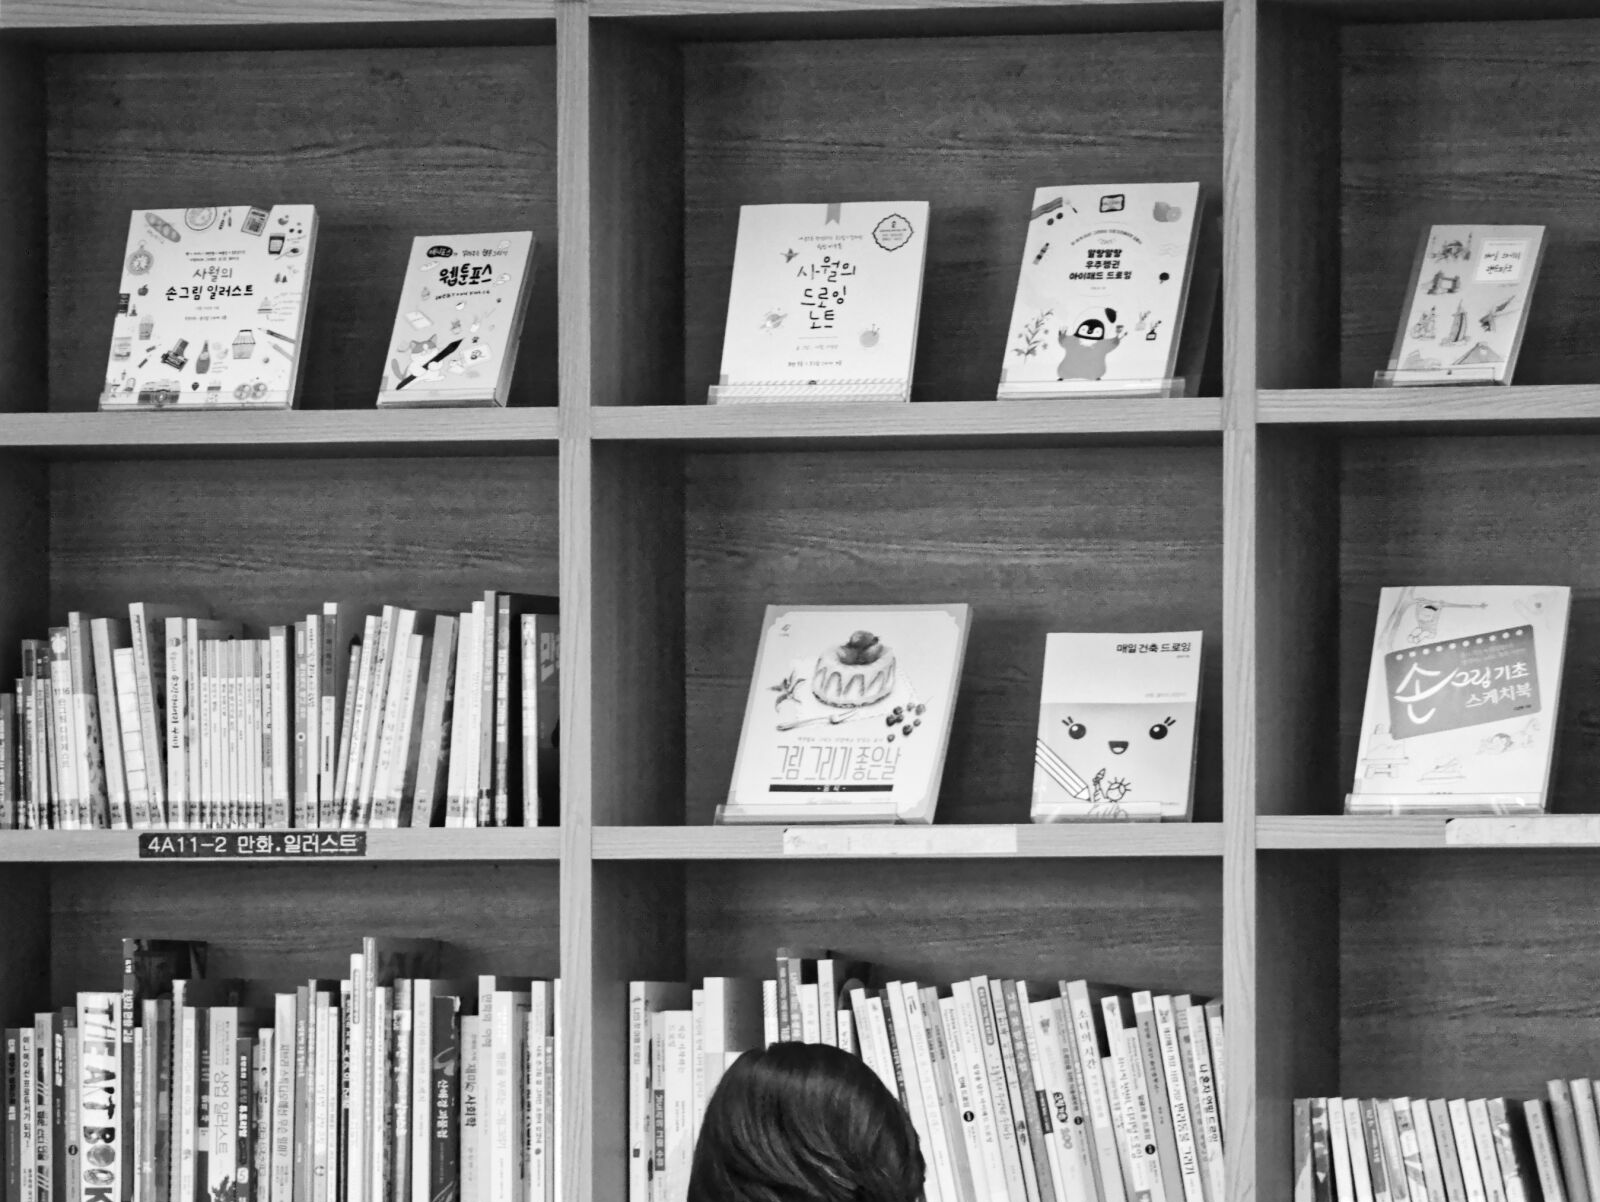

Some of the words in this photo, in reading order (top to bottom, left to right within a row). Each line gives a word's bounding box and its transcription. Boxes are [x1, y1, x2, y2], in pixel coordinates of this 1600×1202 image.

[193, 266, 233, 282] 사월의
[439, 263, 492, 286] 웹툰포스
[797, 256, 856, 282] 사월의
[1069, 271, 1103, 281] 아이패드
[1106, 271, 1132, 280] 드로잉
[165, 286, 202, 301] 손그림
[207, 284, 253, 300] 일러스트
[801, 285, 847, 308] 드로잉
[809, 310, 835, 329] 노트
[1116, 643, 1137, 654] 매일
[1160, 642, 1191, 653] 드로잉
[1394, 662, 1491, 724] 손그림
[1494, 662, 1531, 680] 기초
[1465, 682, 1532, 708] 스케치북
[770, 745, 804, 780] 그림
[804, 746, 852, 780] 그리기
[852, 746, 885, 780] 좋은
[880, 746, 902, 780] 날
[148, 836, 227, 853] 4A11-2
[237, 834, 358, 853] 만화.일러스트
[83, 999, 116, 1056] THE
[482, 1028, 492, 1047] 이해
[83, 1065, 116, 1119] ART
[214, 1071, 229, 1096] 상업
[465, 1095, 477, 1127] 사회학
[214, 1102, 229, 1154] 일러스트
